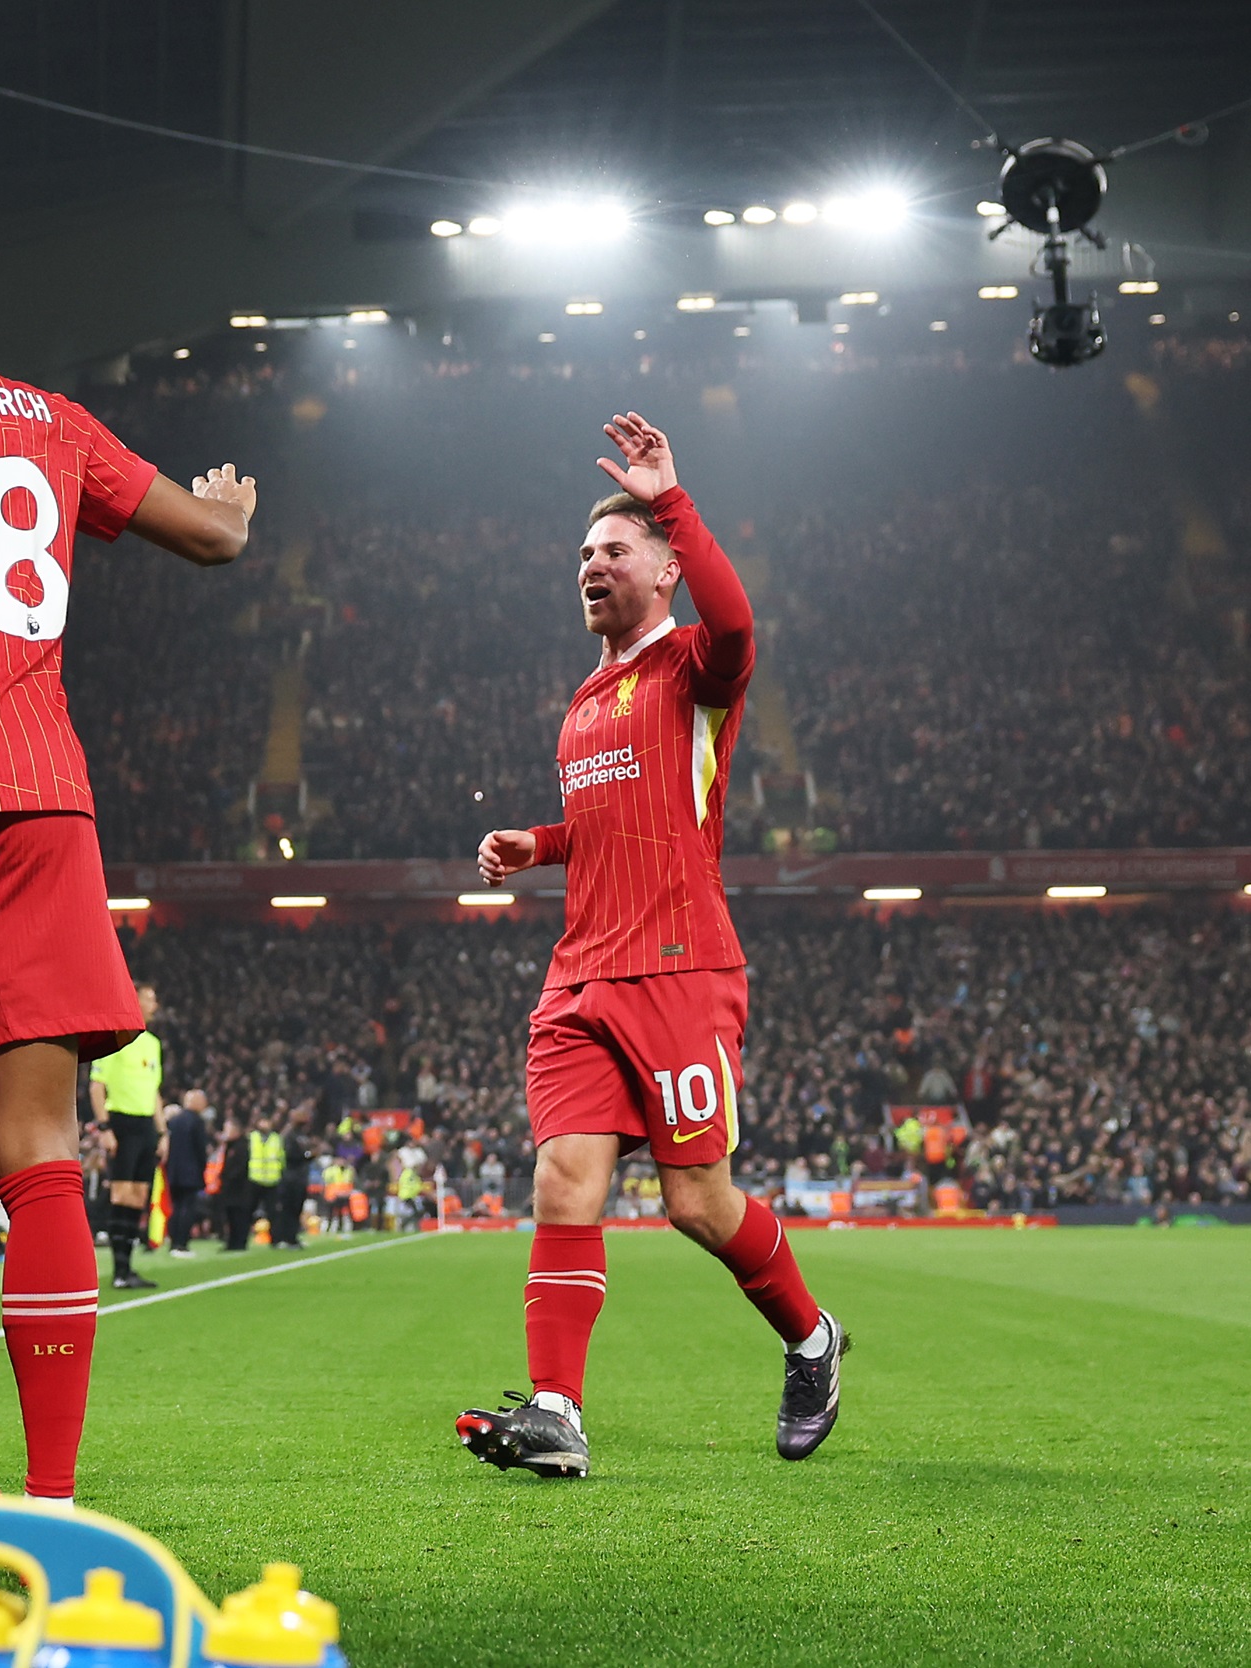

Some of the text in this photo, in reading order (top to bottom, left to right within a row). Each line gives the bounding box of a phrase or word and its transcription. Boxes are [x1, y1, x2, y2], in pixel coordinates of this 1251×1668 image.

[565, 743, 634, 779] standard
[565, 760, 642, 795] chartered
[653, 1062, 718, 1126] 10
[33, 1344, 75, 1356] LFC
